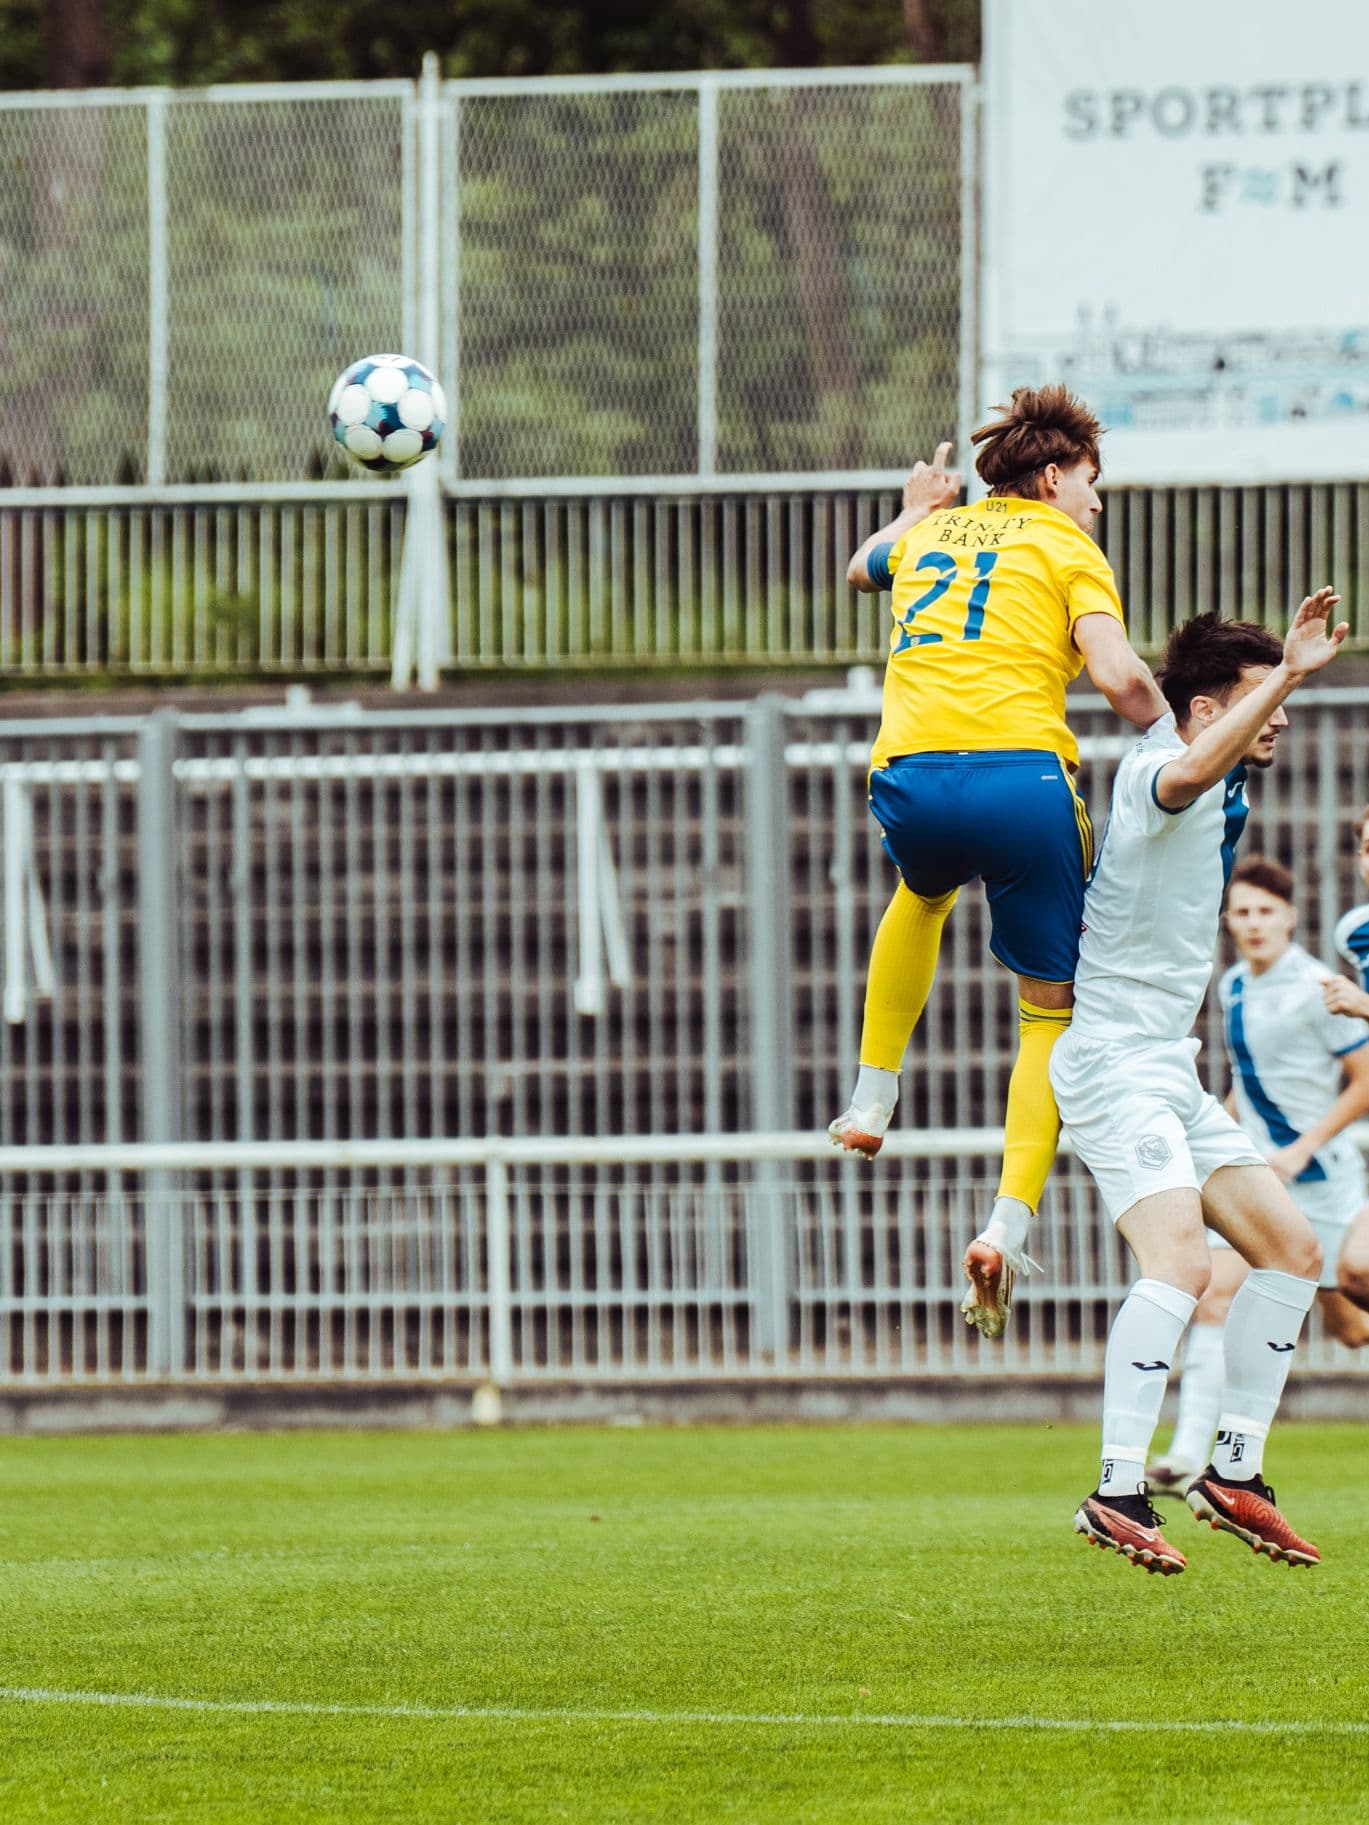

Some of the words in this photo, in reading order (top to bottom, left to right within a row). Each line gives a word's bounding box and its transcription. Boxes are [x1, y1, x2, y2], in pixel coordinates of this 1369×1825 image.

[985, 500, 1009, 513] U21
[933, 513, 1032, 532] TRINTY
[938, 528, 1005, 547] BANK
[893, 551, 998, 656] 21
